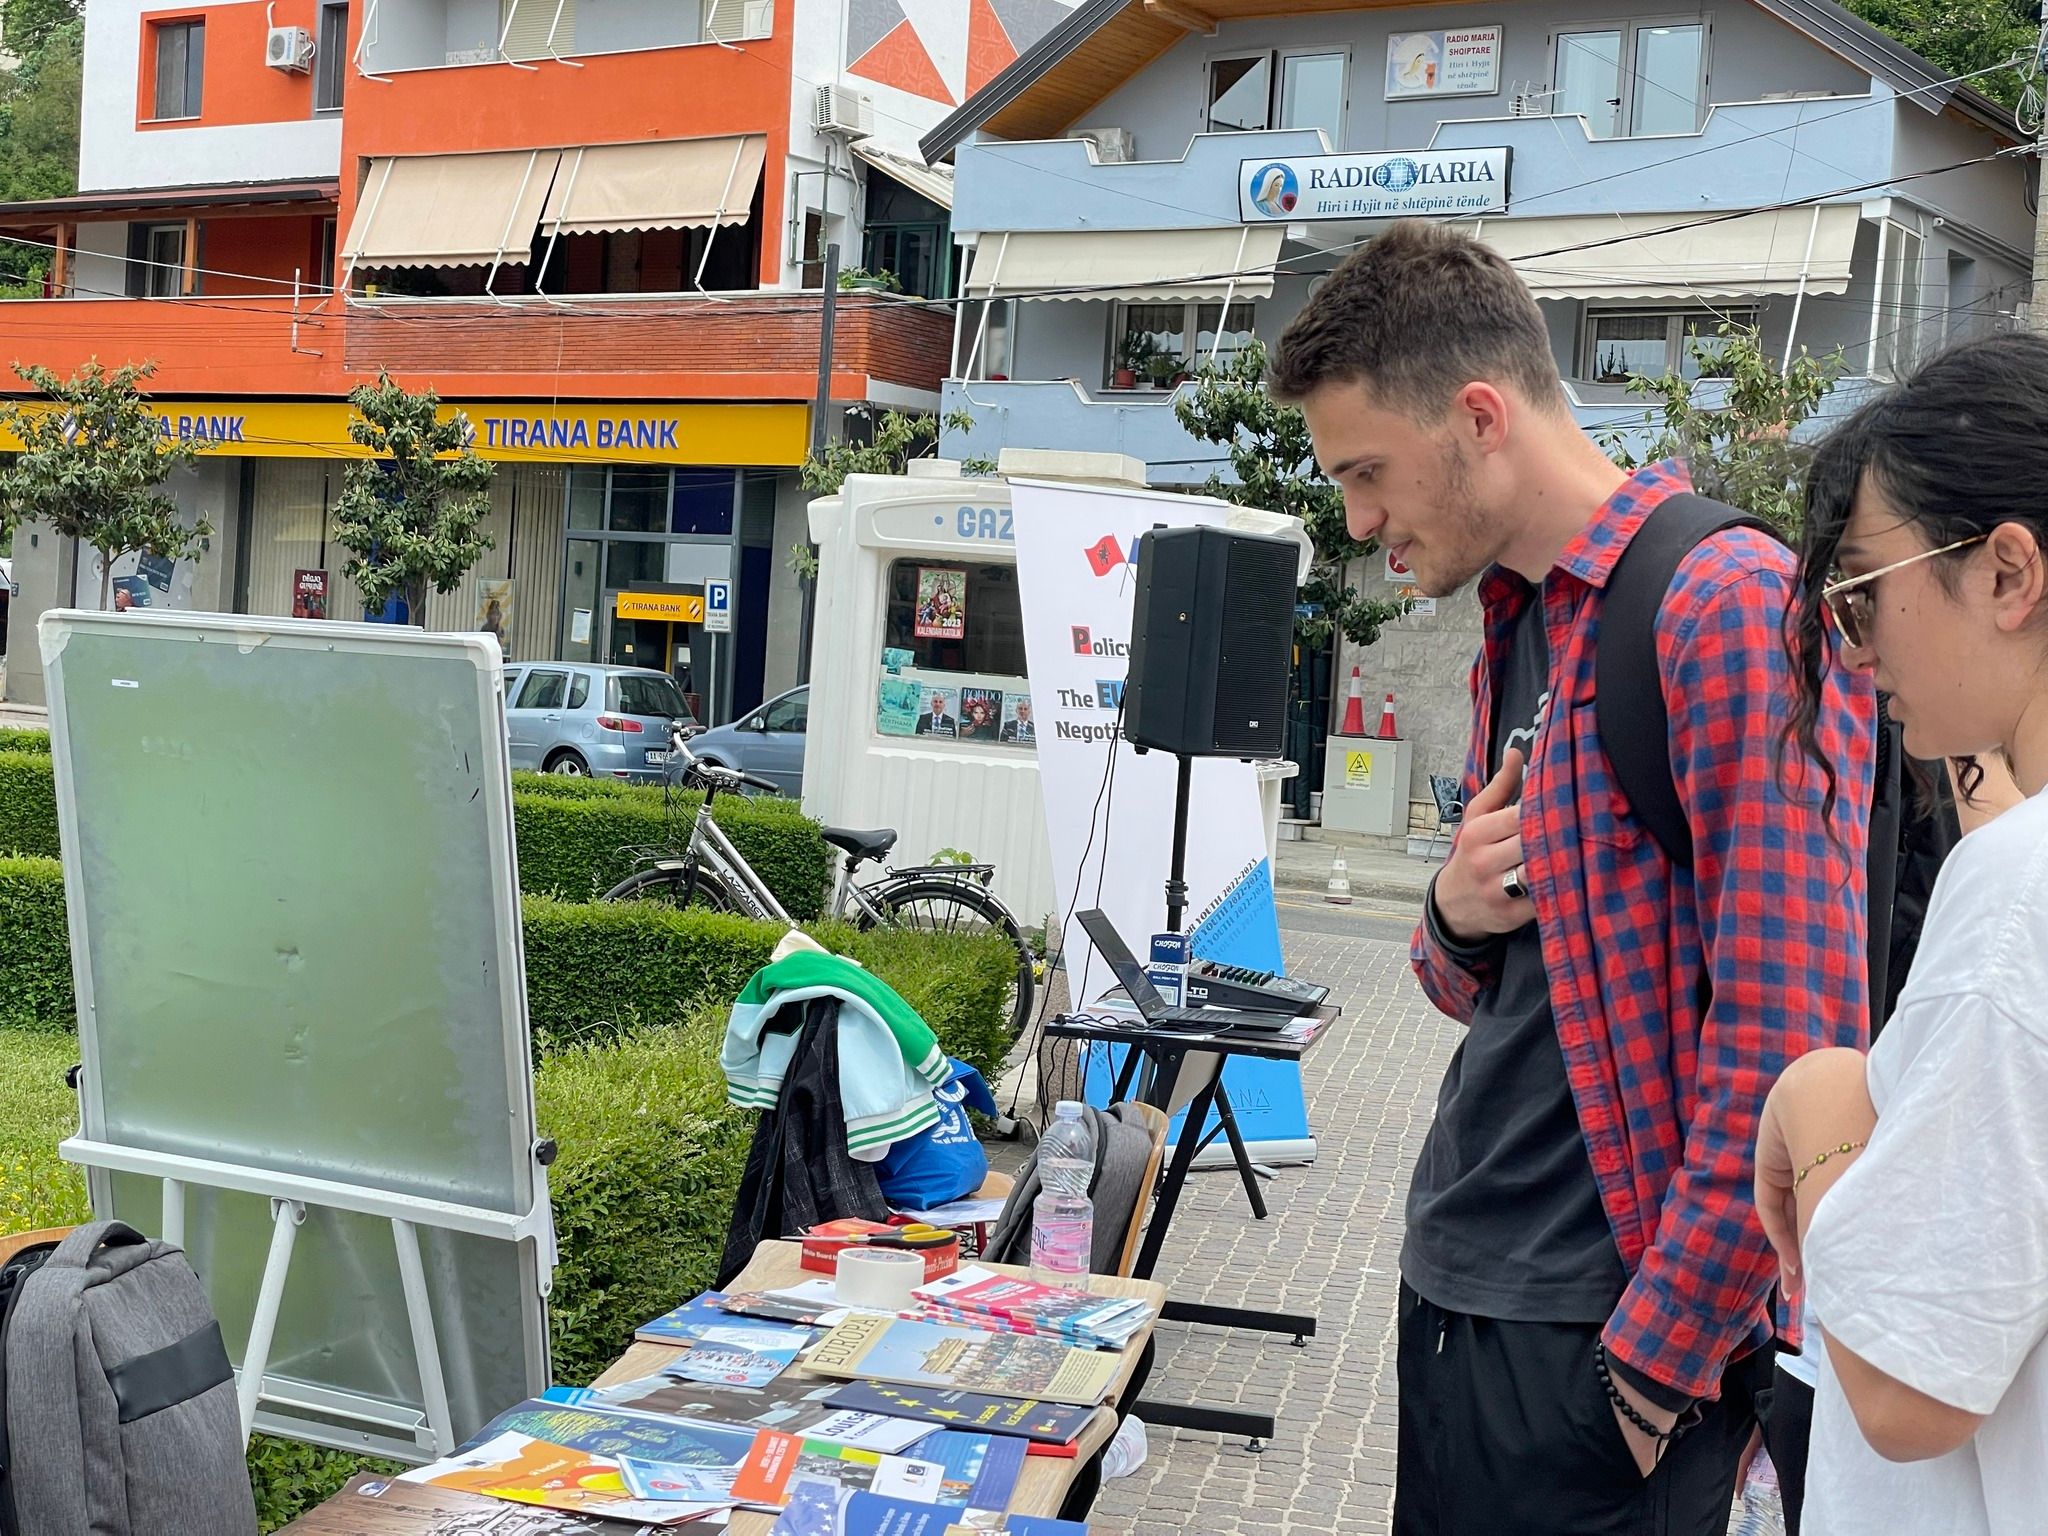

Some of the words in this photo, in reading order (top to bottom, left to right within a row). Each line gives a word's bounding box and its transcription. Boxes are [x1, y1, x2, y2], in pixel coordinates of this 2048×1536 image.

[1446, 34, 1469, 43] RADIO
[1471, 33, 1495, 41] MARIA
[1449, 46, 1491, 56] SHQIPTARE
[1309, 165, 1391, 190] RADIO
[1404, 160, 1495, 185] MARIA
[1317, 201, 1341, 213] Hiri
[1352, 199, 1382, 215] Hyjit
[1385, 198, 1399, 210] në
[1402, 195, 1454, 213] shtëpinë
[1456, 194, 1490, 208] tënde
[177, 415, 246, 441] BANK
[483, 418, 590, 448] TIRANA
[597, 419, 679, 449] BANK
[631, 602, 659, 612] TIRANA
[660, 604, 681, 612] BANK
[713, 587, 726, 607] P
[942, 617, 961, 627] 2023
[1057, 689, 1094, 708] The
[1195, 895, 1223, 925] YOUTH
[1221, 858, 1258, 899] 2022-2023
[1200, 906, 1229, 936] YOUTH
[1228, 869, 1264, 909] 2022-2023
[1207, 917, 1235, 946] YOUTH
[813, 1318, 879, 1366] EUROPA
[809, 1411, 874, 1437] Louise
